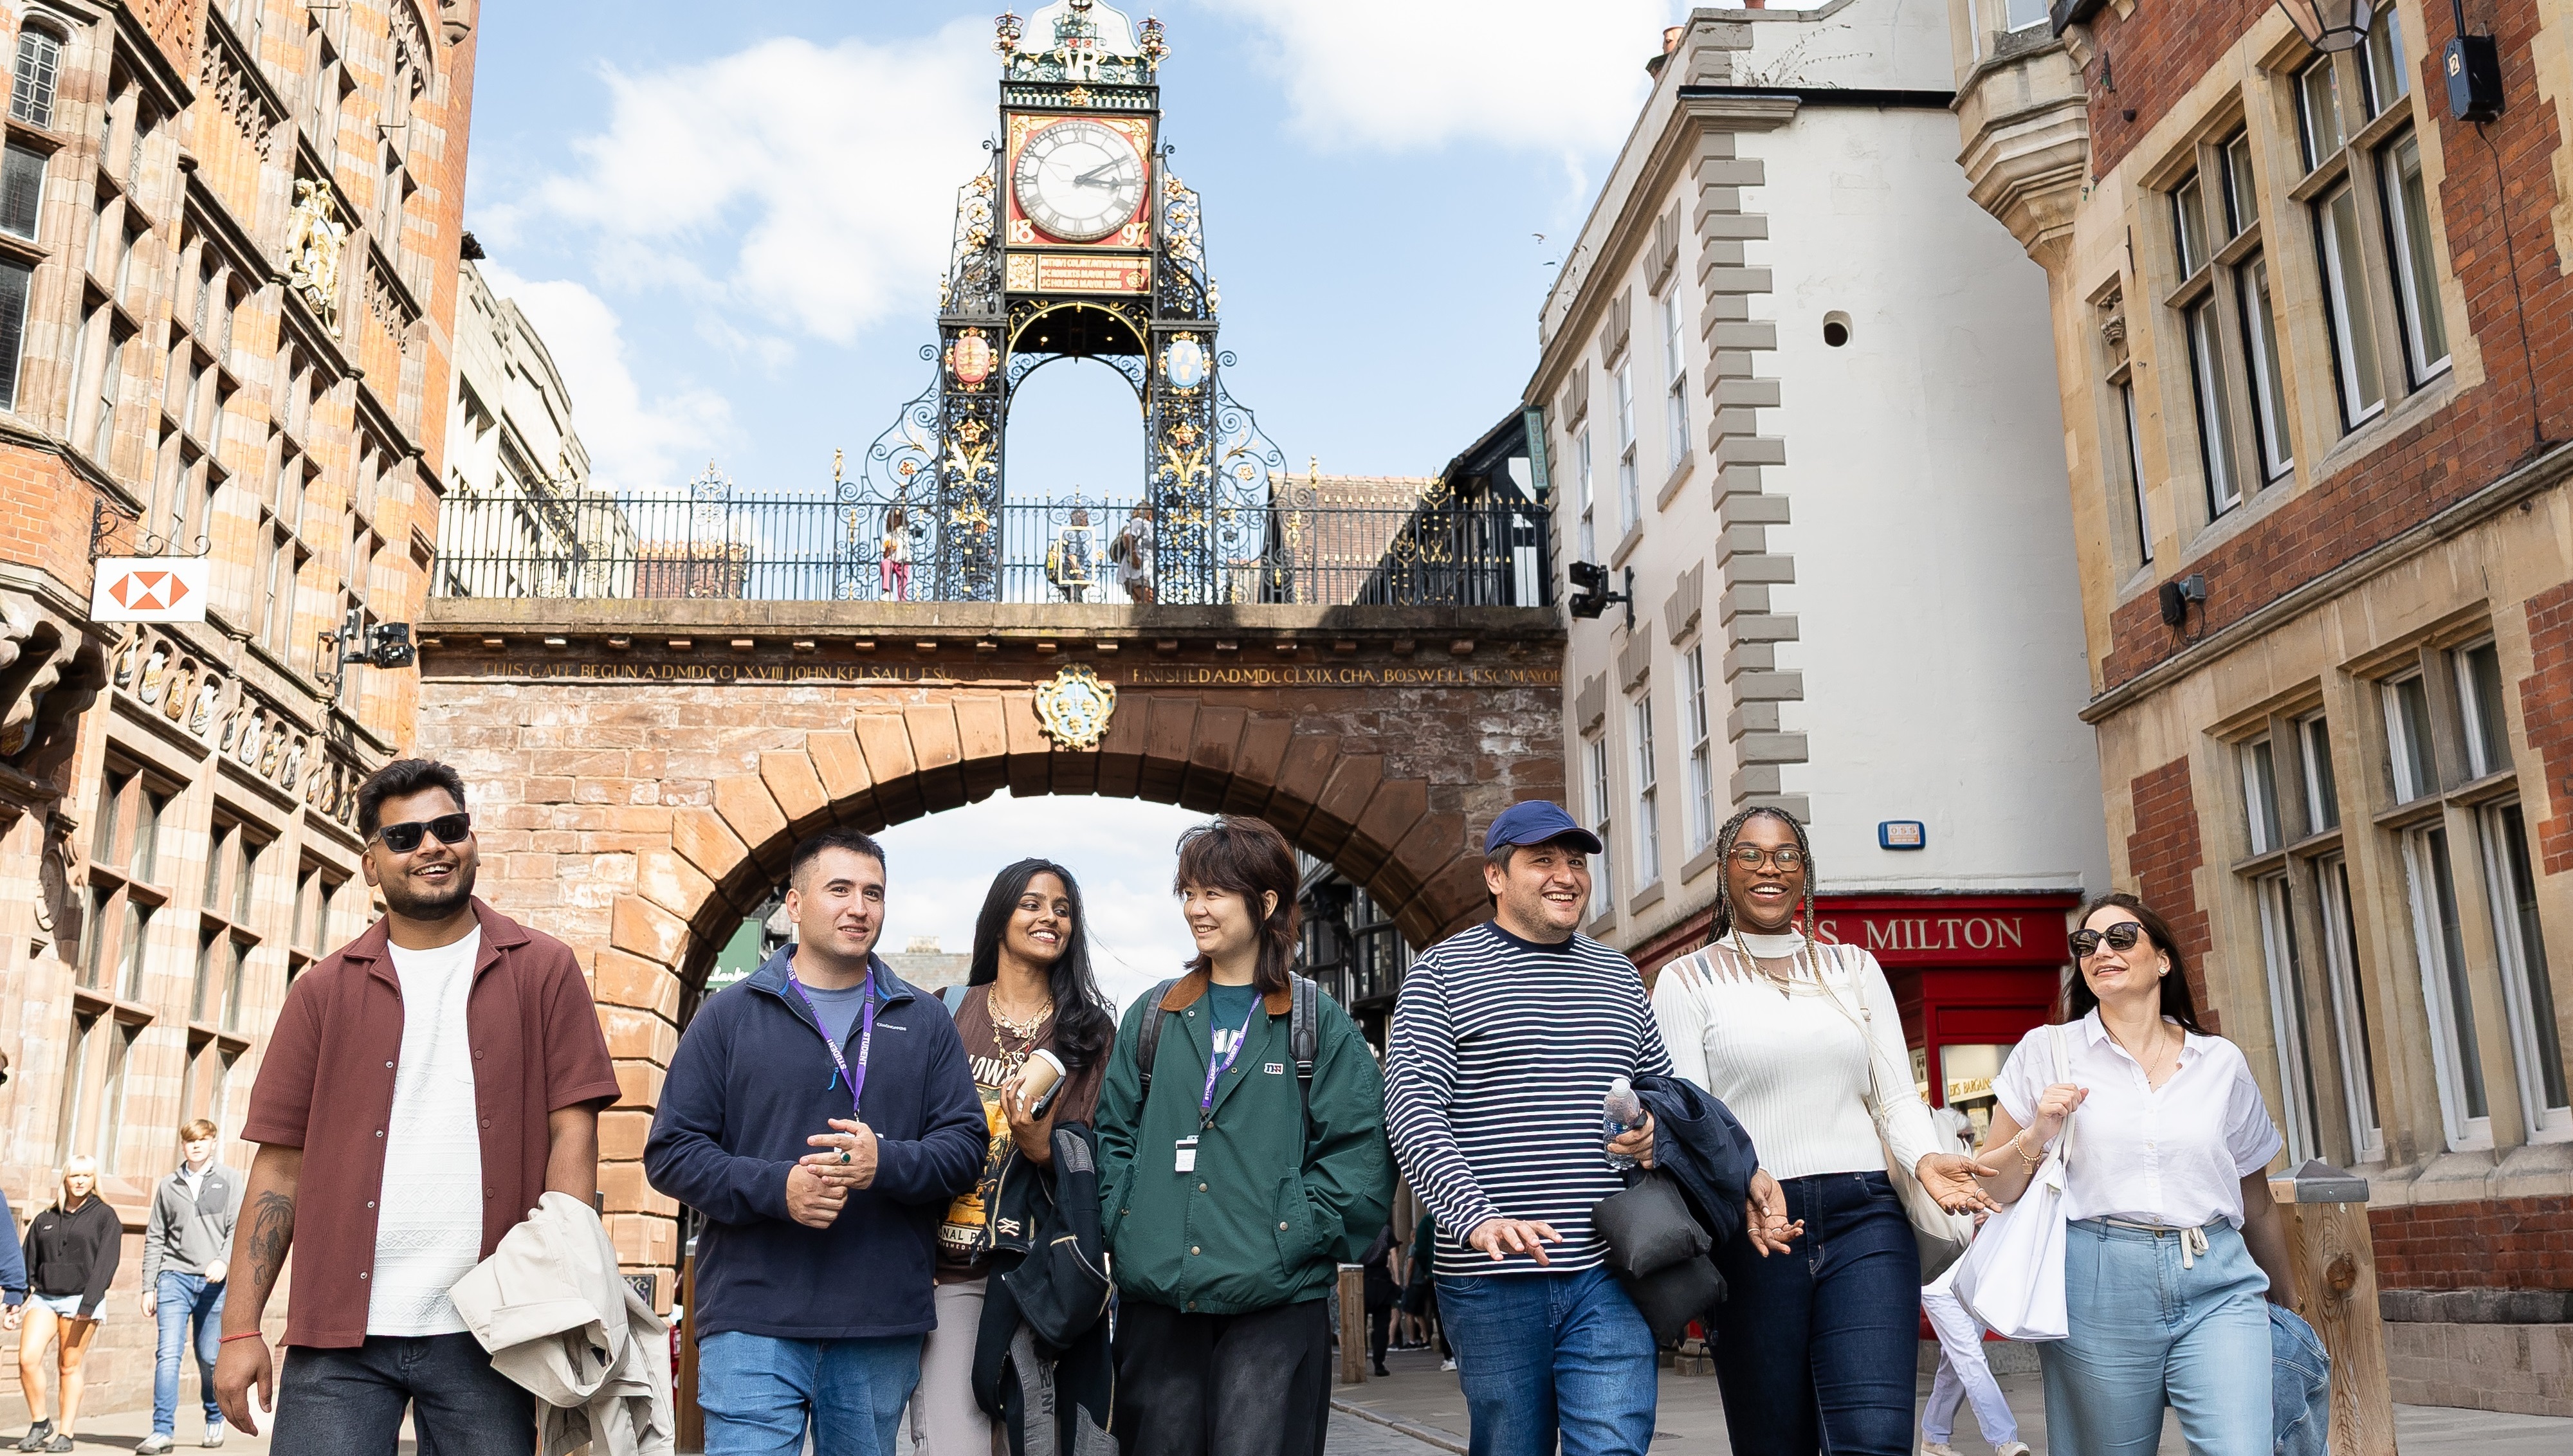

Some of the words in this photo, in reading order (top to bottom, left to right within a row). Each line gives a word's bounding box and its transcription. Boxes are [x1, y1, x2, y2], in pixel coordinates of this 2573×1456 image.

[2451, 57, 2458, 73] 2
[1009, 219, 1036, 243] 18
[1121, 221, 1148, 246] 97
[581, 664, 637, 678] BEGUN
[789, 666, 831, 680] JOHN
[1384, 669, 1469, 684] BOSWELL
[1863, 917, 2023, 950] MILTON
[859, 1031, 871, 1067] STUDENT
[1041, 1392, 1055, 1415] NY
